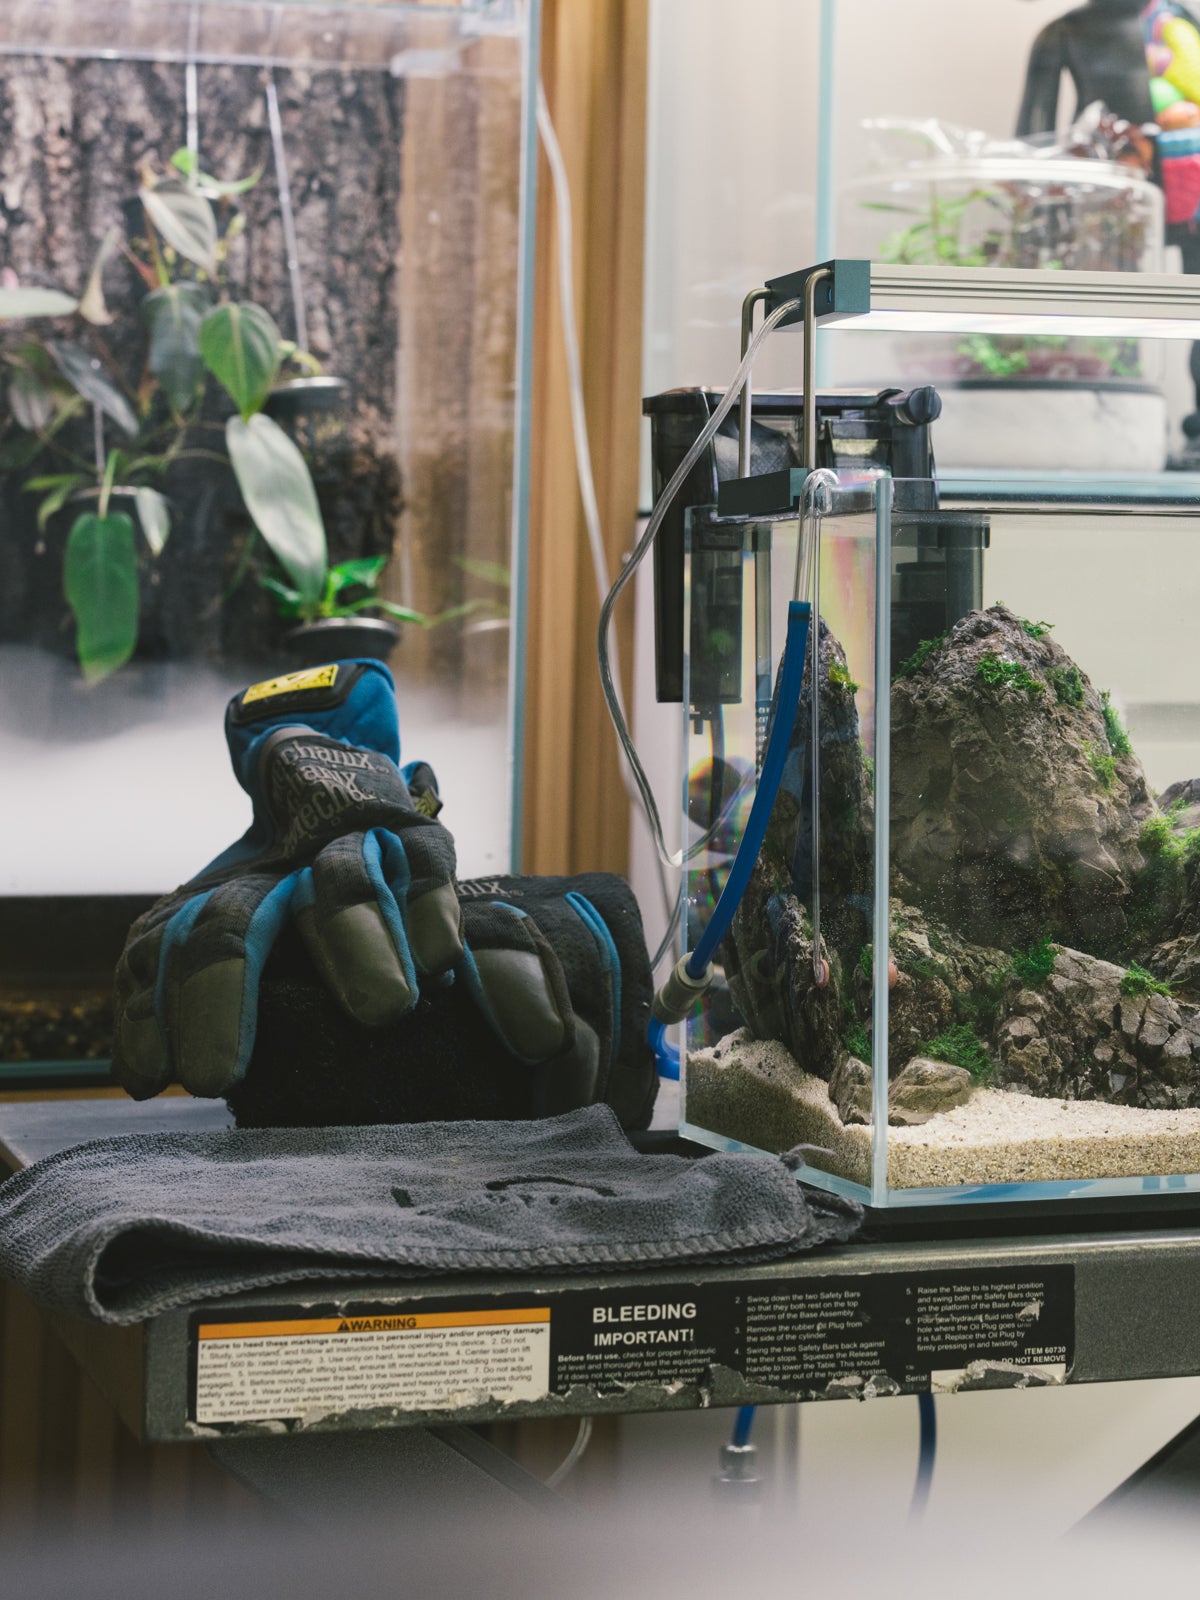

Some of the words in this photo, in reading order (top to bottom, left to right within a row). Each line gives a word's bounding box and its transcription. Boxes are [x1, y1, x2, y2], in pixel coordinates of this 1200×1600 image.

[990, 1282, 1015, 1292] highest
[1016, 1281, 1043, 1290] position
[932, 1294, 952, 1303] swing
[983, 1292, 1005, 1301] Safety
[592, 1303, 696, 1323] BLEEDING
[940, 1303, 969, 1312] platform
[350, 1317, 416, 1330] WARNING
[980, 1322, 997, 1331] Plug
[593, 1329, 694, 1346] IMPORTANT!
[944, 1332, 973, 1342] Replace
[998, 1330, 1015, 1339] Plug
[1016, 1329, 1025, 1338] by
[916, 1343, 935, 1352] firmly
[937, 1342, 967, 1351] pressing
